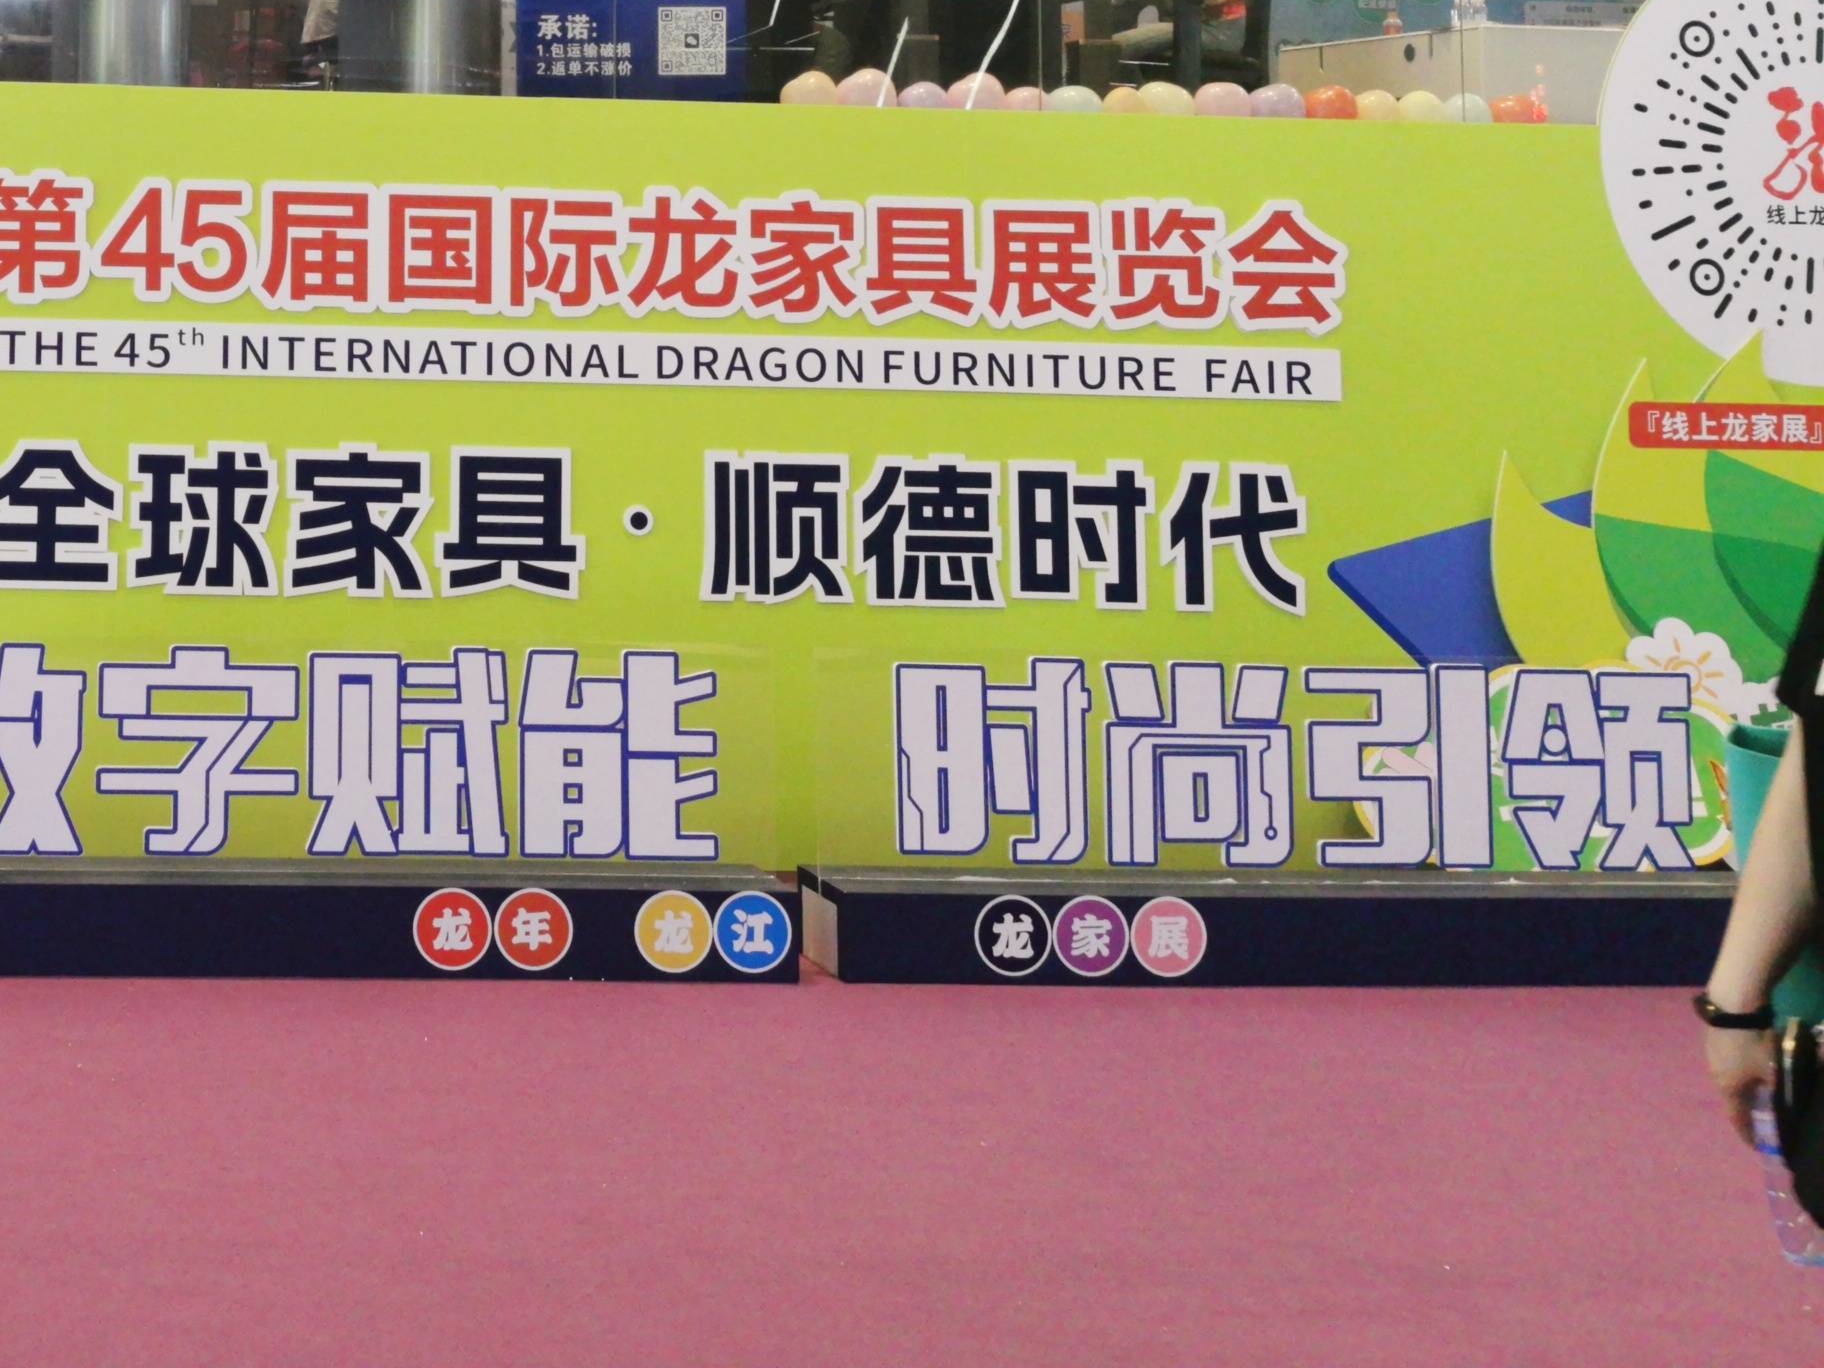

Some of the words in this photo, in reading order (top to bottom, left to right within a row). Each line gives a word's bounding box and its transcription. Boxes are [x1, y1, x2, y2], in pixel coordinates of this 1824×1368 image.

[537, 43, 632, 59] 1.包运输破损
[537, 60, 633, 77] 2.返单不涨价
[221, 334, 639, 381] INTERNATIONAL
[656, 342, 865, 384] DRAGON
[883, 349, 1177, 392] FURNITURE
[1204, 357, 1314, 396] FAIR
[891, 655, 1701, 873] 时尚引领
[431, 909, 554, 955] 龙年
[653, 908, 776, 957] 龙江
[991, 914, 1191, 960] 龙家展
